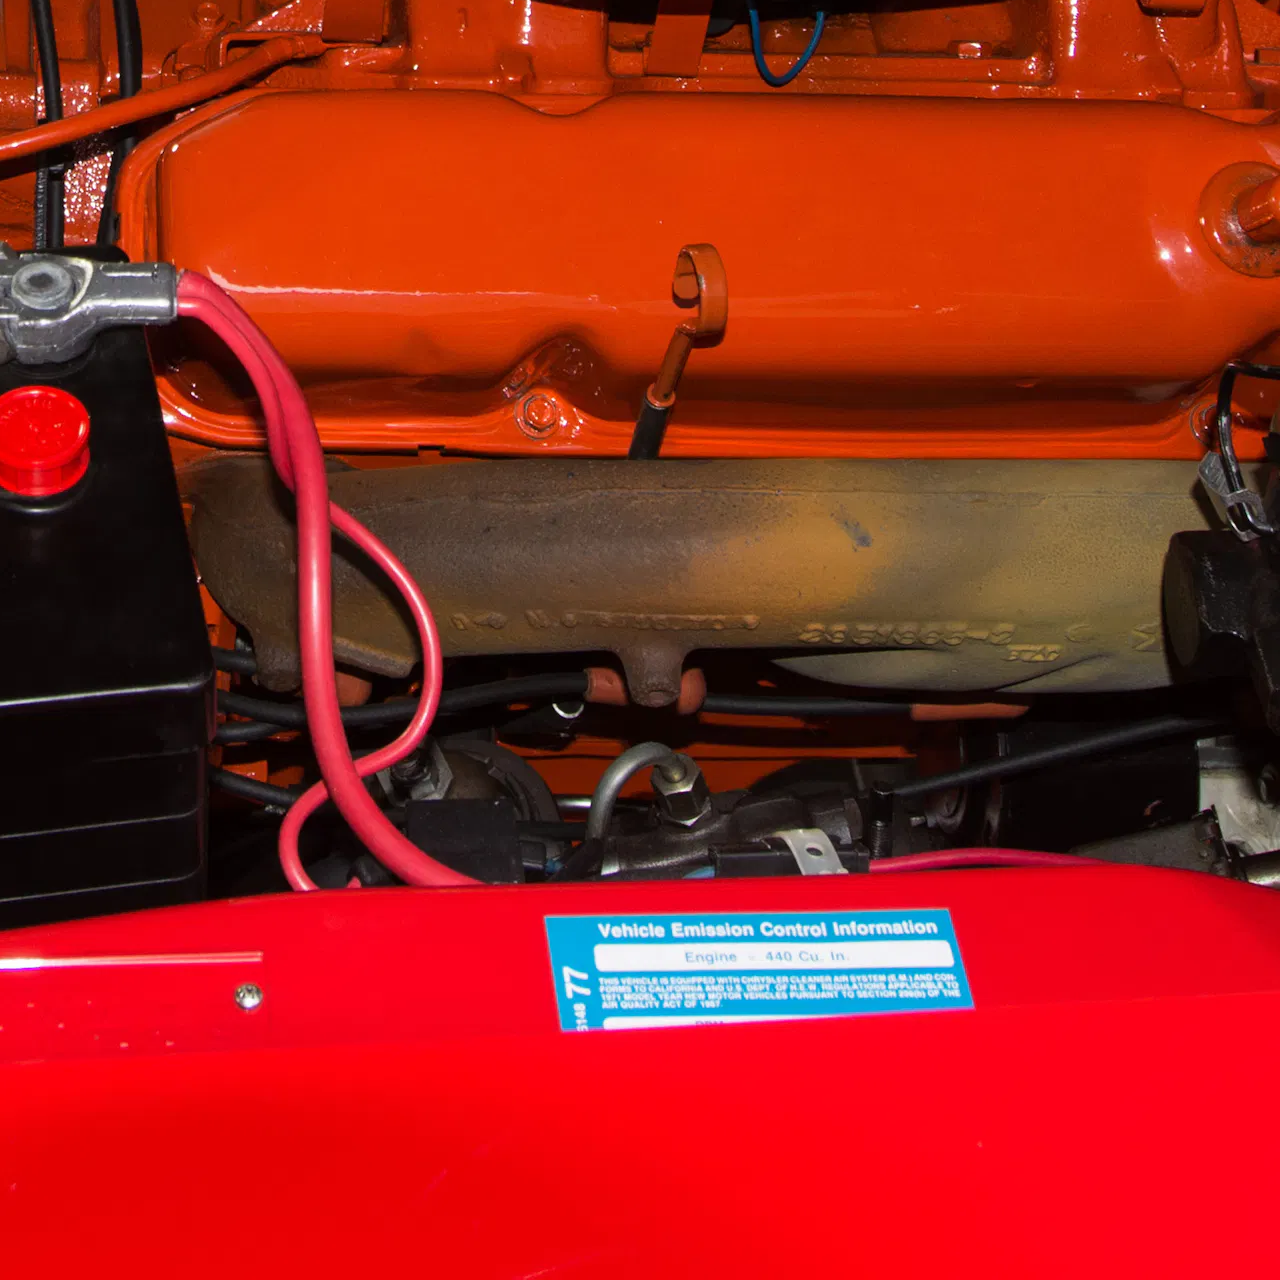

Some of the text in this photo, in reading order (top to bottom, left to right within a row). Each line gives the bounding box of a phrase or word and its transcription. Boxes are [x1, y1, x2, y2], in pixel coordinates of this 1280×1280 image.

[598, 919, 938, 938] Vehicle Emission Control Information
[685, 951, 737, 965] Engine
[765, 951, 792, 961] 440
[562, 966, 589, 999] 77
[620, 1000, 660, 1008] QUALITY
[663, 1000, 681, 1008] ACT
[684, 1000, 697, 1008] OF
